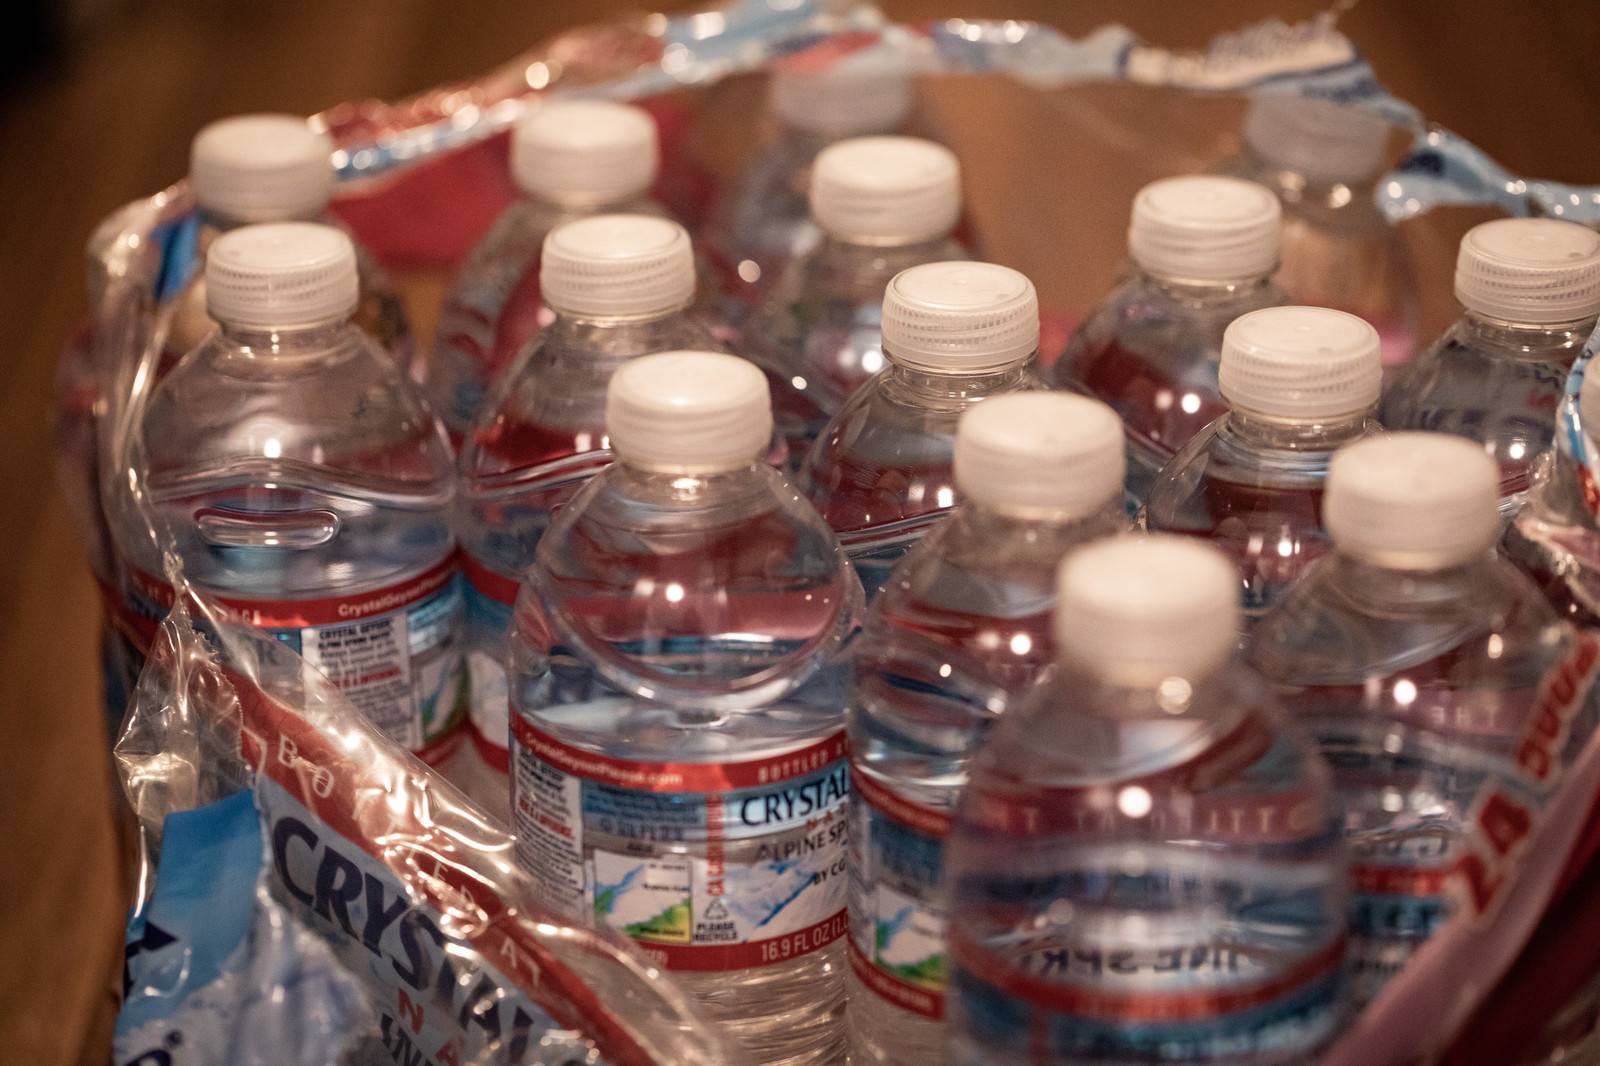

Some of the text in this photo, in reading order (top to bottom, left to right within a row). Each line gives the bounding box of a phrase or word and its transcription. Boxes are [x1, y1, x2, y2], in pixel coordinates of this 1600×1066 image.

[740, 766, 849, 826] CRYSTAL
[755, 829, 827, 863] ALPINE
[813, 869, 830, 886] BY
[696, 921, 735, 931] PLEASE
[761, 931, 792, 962] 16.9
[793, 931, 810, 952] FL
[812, 923, 831, 946] OZ
